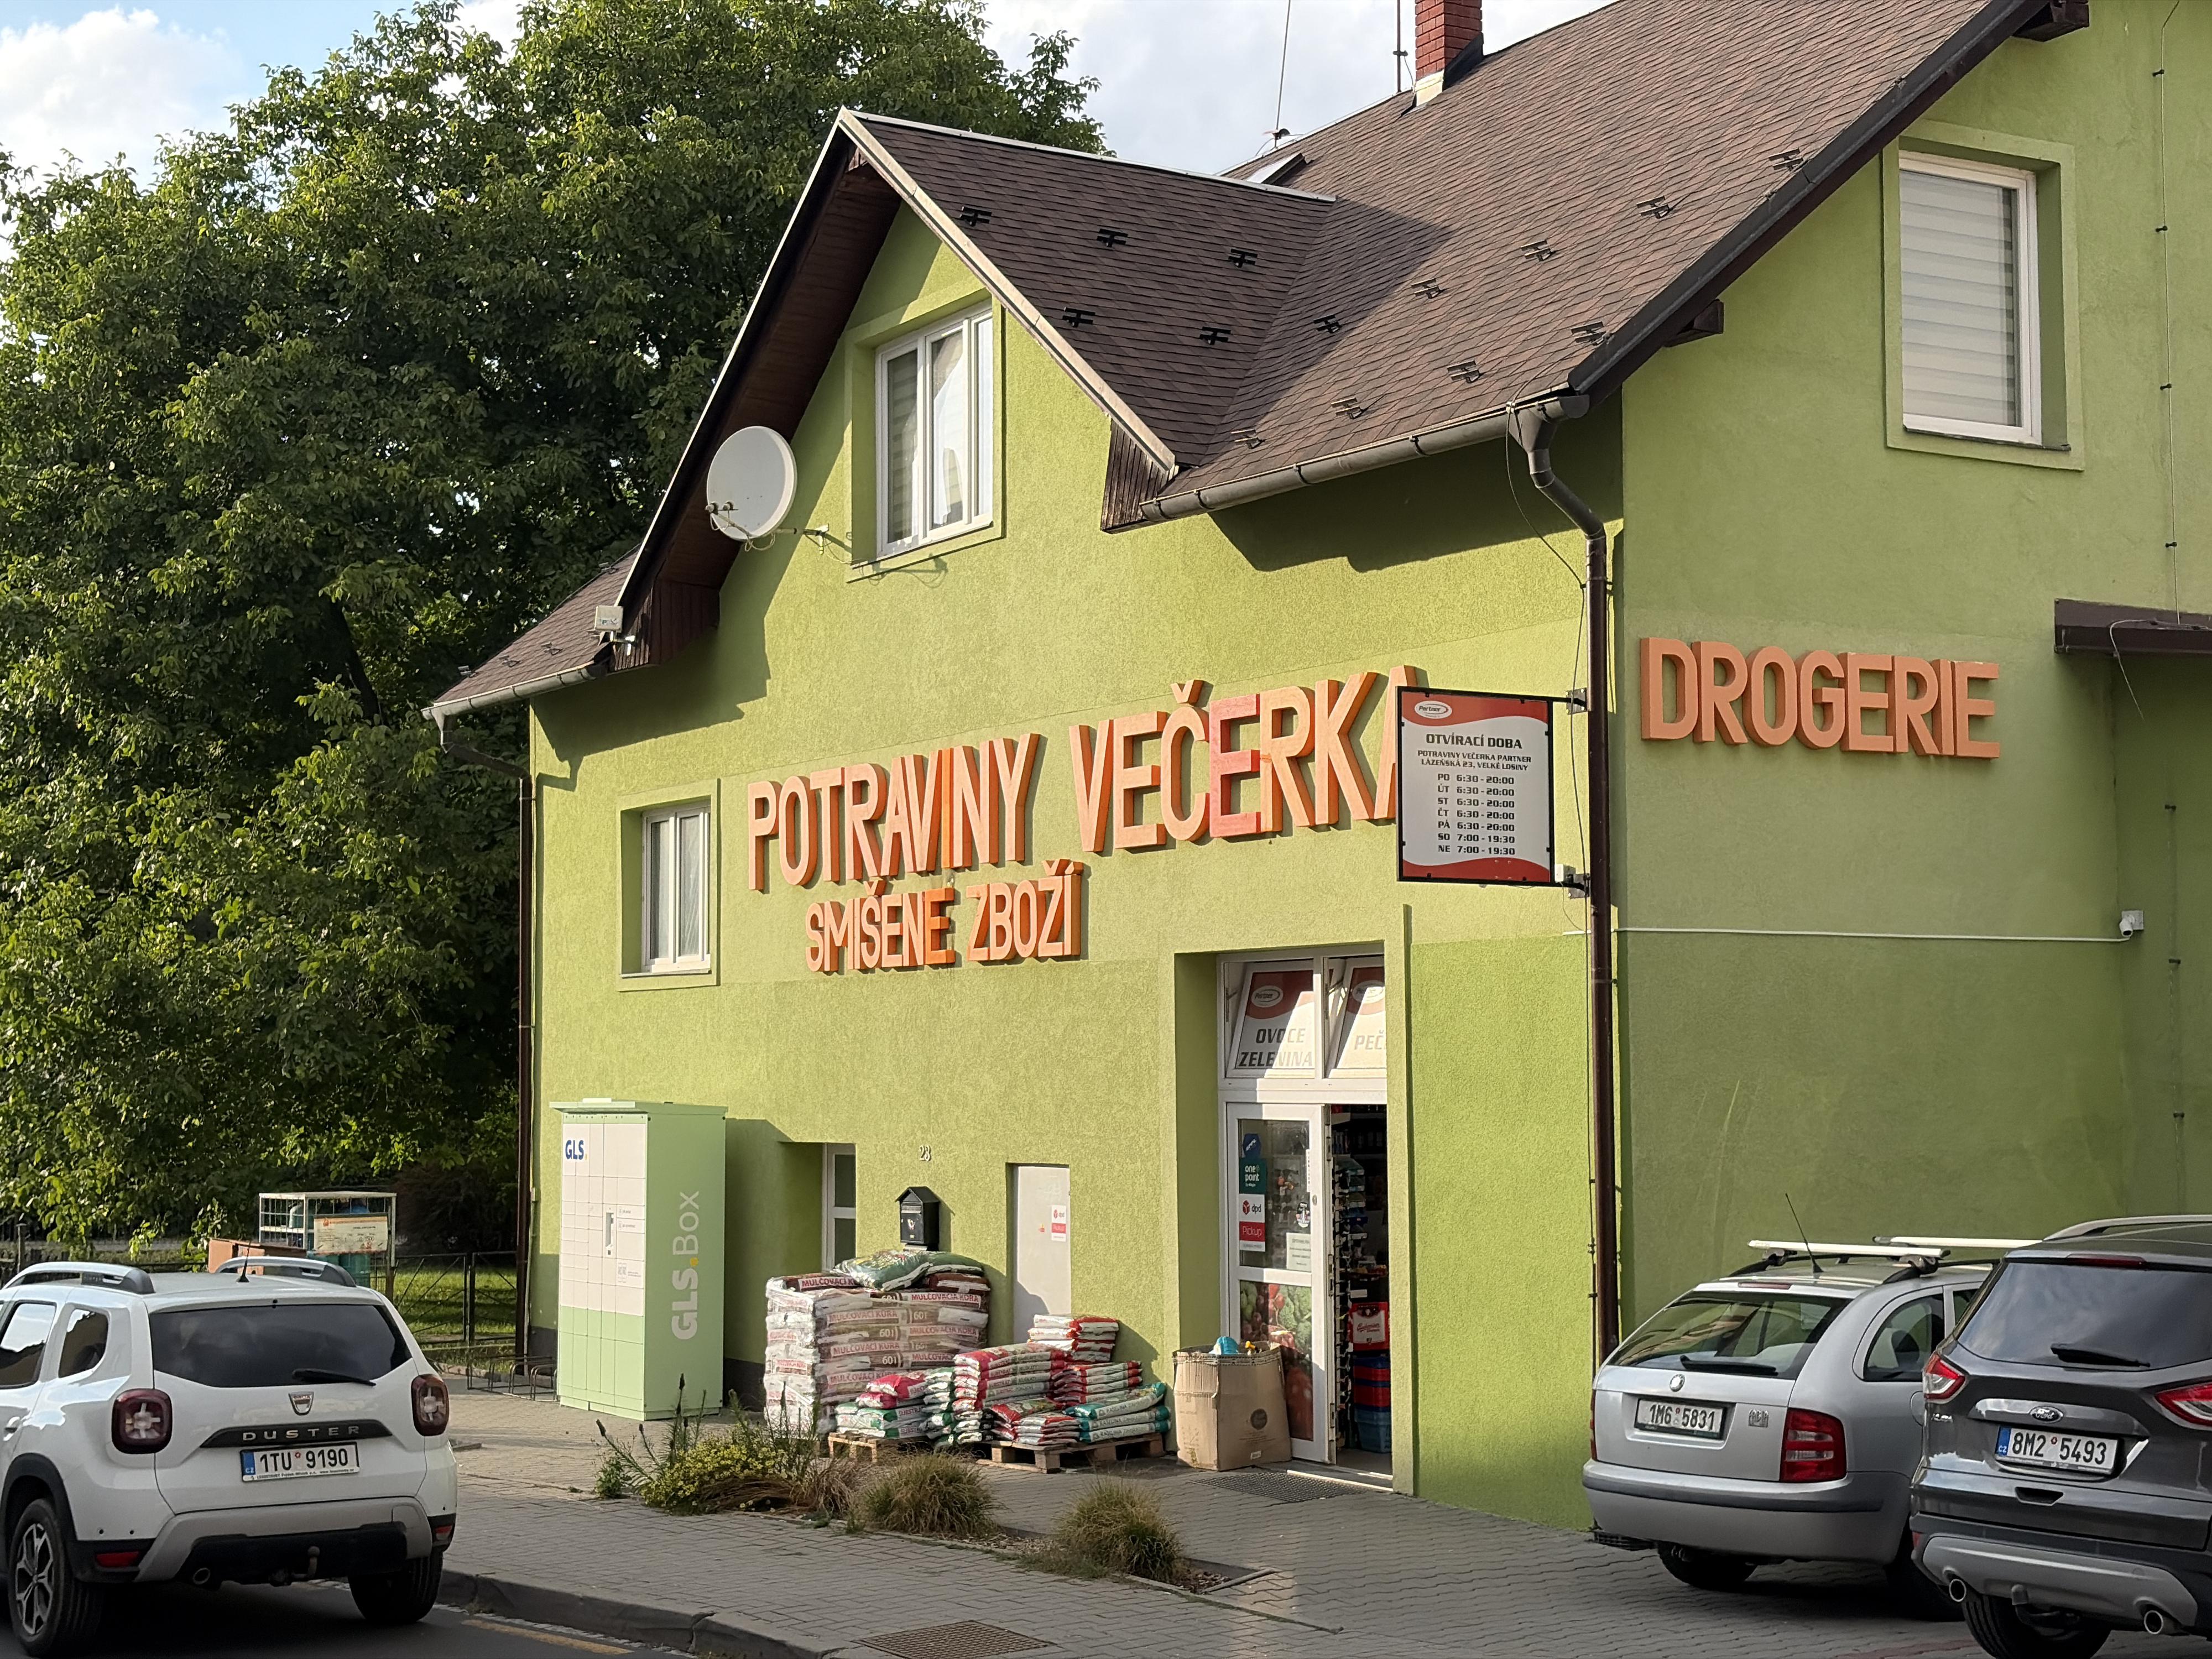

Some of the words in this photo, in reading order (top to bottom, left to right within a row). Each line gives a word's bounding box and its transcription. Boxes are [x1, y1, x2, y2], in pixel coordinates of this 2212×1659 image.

[1641, 637, 2000, 758] DROGERIE
[1426, 732, 1484, 747] OTVÍRACÍ
[1488, 737, 1522, 749] DOBA
[1417, 750, 1460, 759] POTRAVINY
[1462, 752, 1495, 761] VEČERKA
[1497, 754, 1532, 763] PARTNER
[1421, 758, 1461, 767] LÁZEŇSKÁ
[1457, 774, 1478, 782] 6:30
[1486, 776, 1514, 784] 20:00
[1438, 783, 1449, 792] ÚT
[1486, 788, 1515, 796] 20:00
[1457, 798, 1479, 806] 6:30
[1486, 800, 1515, 808] 20:00
[748, 733, 1040, 891] POTRAVINY
[1438, 807, 1449, 817] ČT
[1457, 810, 1479, 818] 6:30
[1486, 811, 1515, 820] 20:00
[1438, 820, 1450, 828] PÁ
[967, 859, 1084, 961] ZBOŽÍ
[1256, 1028, 1306, 1044] OVOCE
[1354, 1030, 1386, 1050] PEČ
[1238, 1052, 1313, 1067] ZELENINA
[1245, 1173, 1260, 1182] point
[1251, 1204, 1261, 1214] dpd
[1242, 1226, 1262, 1238] Pickup
[1650, 1404, 1673, 1425] 1M6
[1682, 1408, 1715, 1431] 5831
[2035, 1408, 2054, 1420] Ford
[243, 1426, 359, 1441] DUSTER
[1998, 1445, 2006, 1453] CZ
[2012, 1432, 2047, 1457] 8M2
[2059, 1438, 2107, 1465] 5493
[260, 1452, 292, 1472] 1TU
[306, 1448, 348, 1468] 9190
